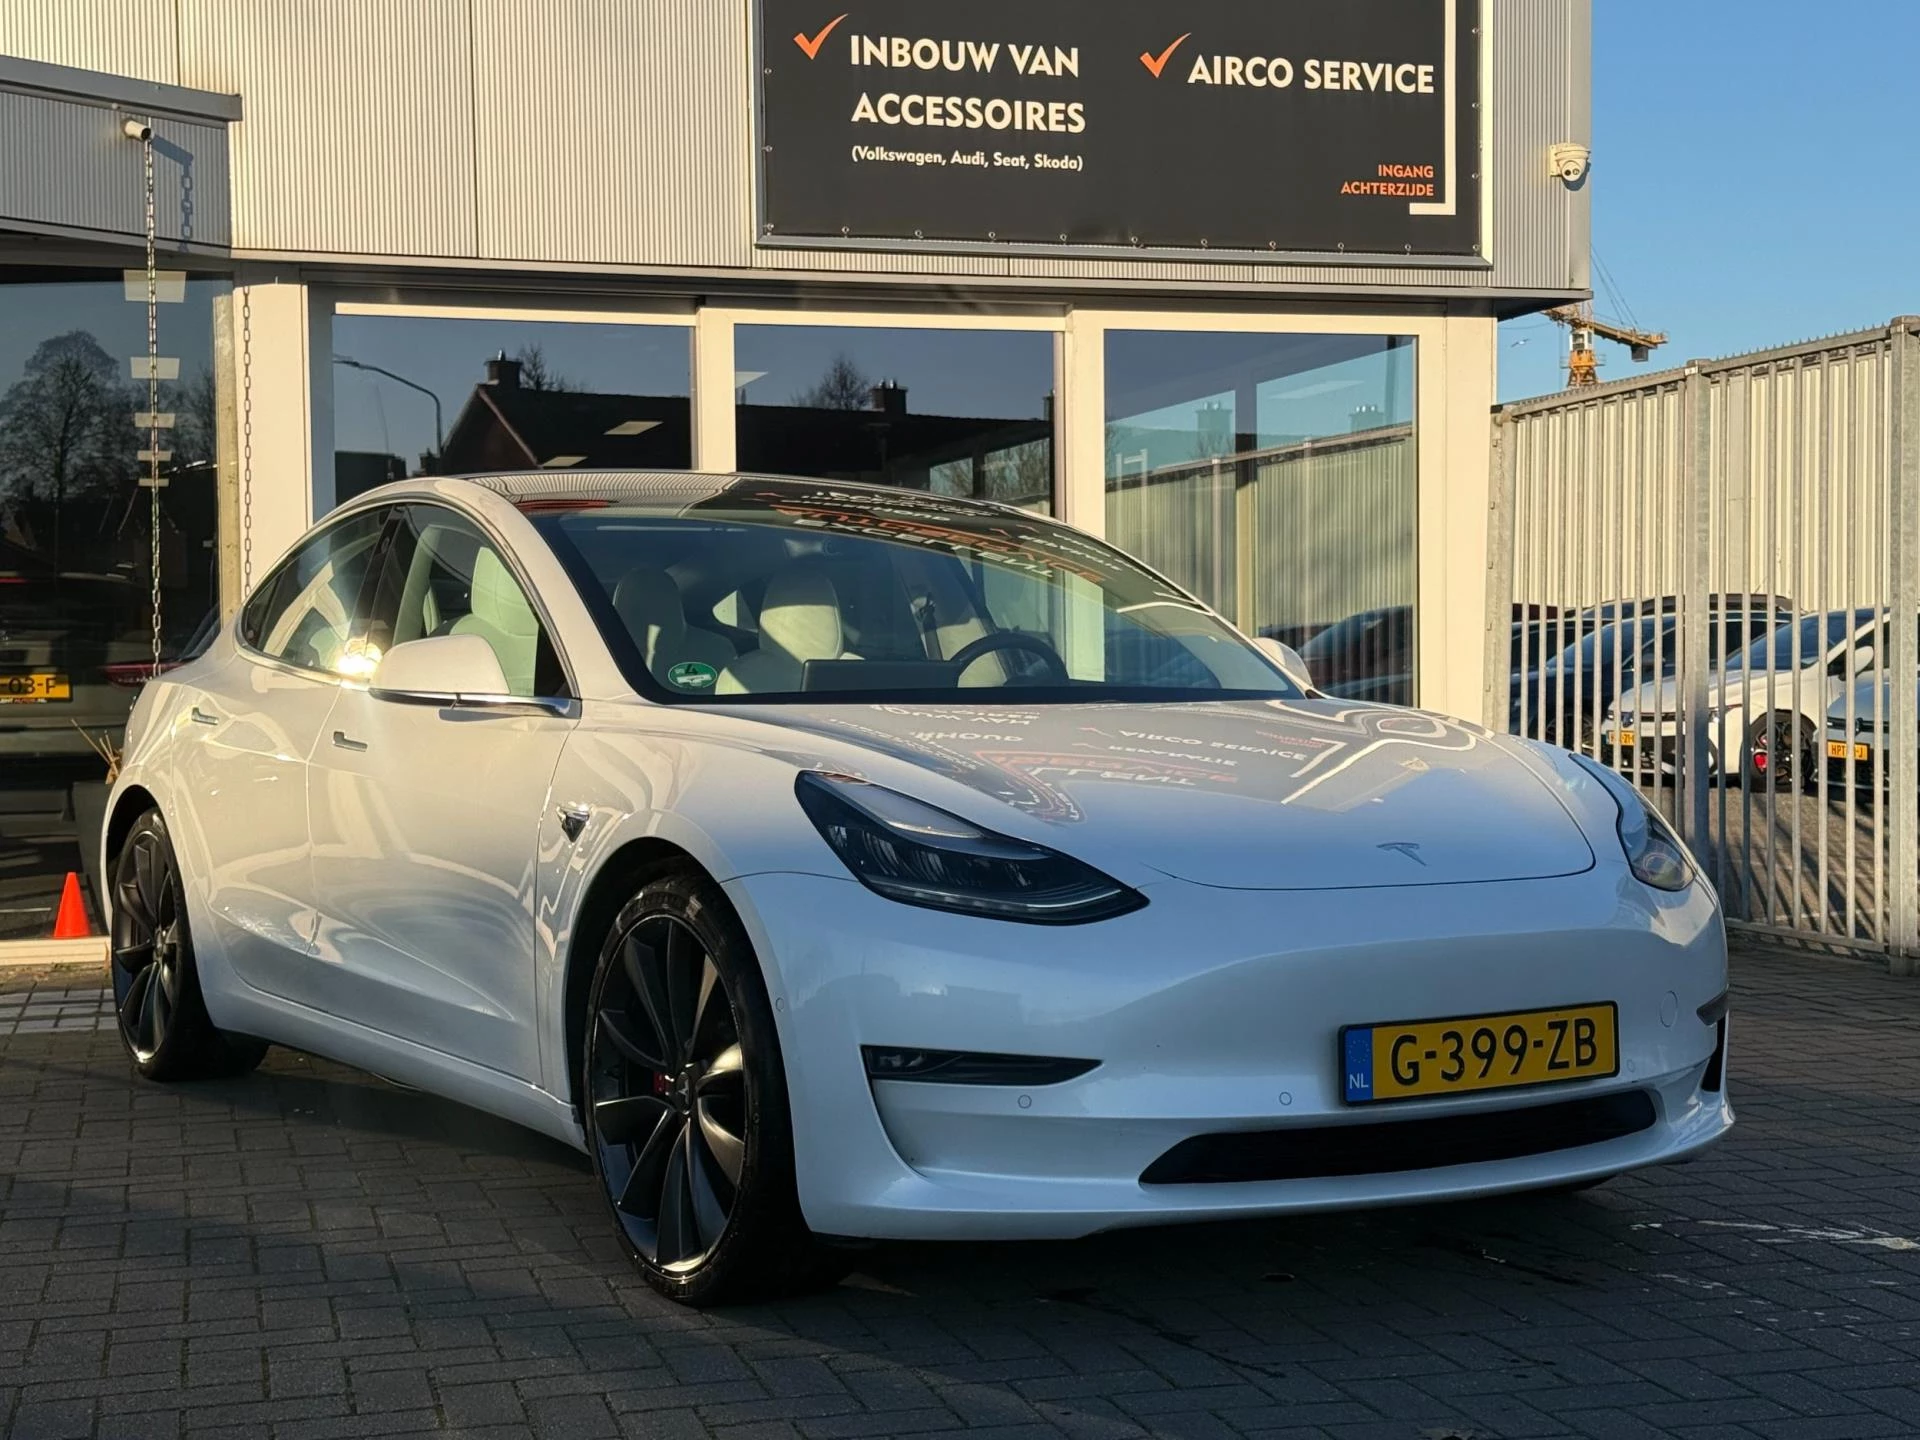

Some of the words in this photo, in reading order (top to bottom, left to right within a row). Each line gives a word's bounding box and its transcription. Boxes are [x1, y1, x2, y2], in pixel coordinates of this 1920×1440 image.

[850, 34, 1001, 74] INBOUW
[1008, 43, 1079, 78] VAN
[1187, 54, 1294, 89] AIRCO
[1303, 58, 1435, 94] SERVICE
[850, 91, 1086, 134] ACCESSOIRES
[851, 144, 947, 167] (Volkswagen,
[950, 149, 989, 169] Audi,
[992, 151, 1030, 170] Seat,
[1033, 152, 1084, 172] Skoda)
[1377, 164, 1434, 179] INGANG
[1340, 181, 1435, 197] ACHTERZIJDE
[1391, 1017, 1597, 1086] G-399-ZB
[1349, 1073, 1369, 1089] NL
